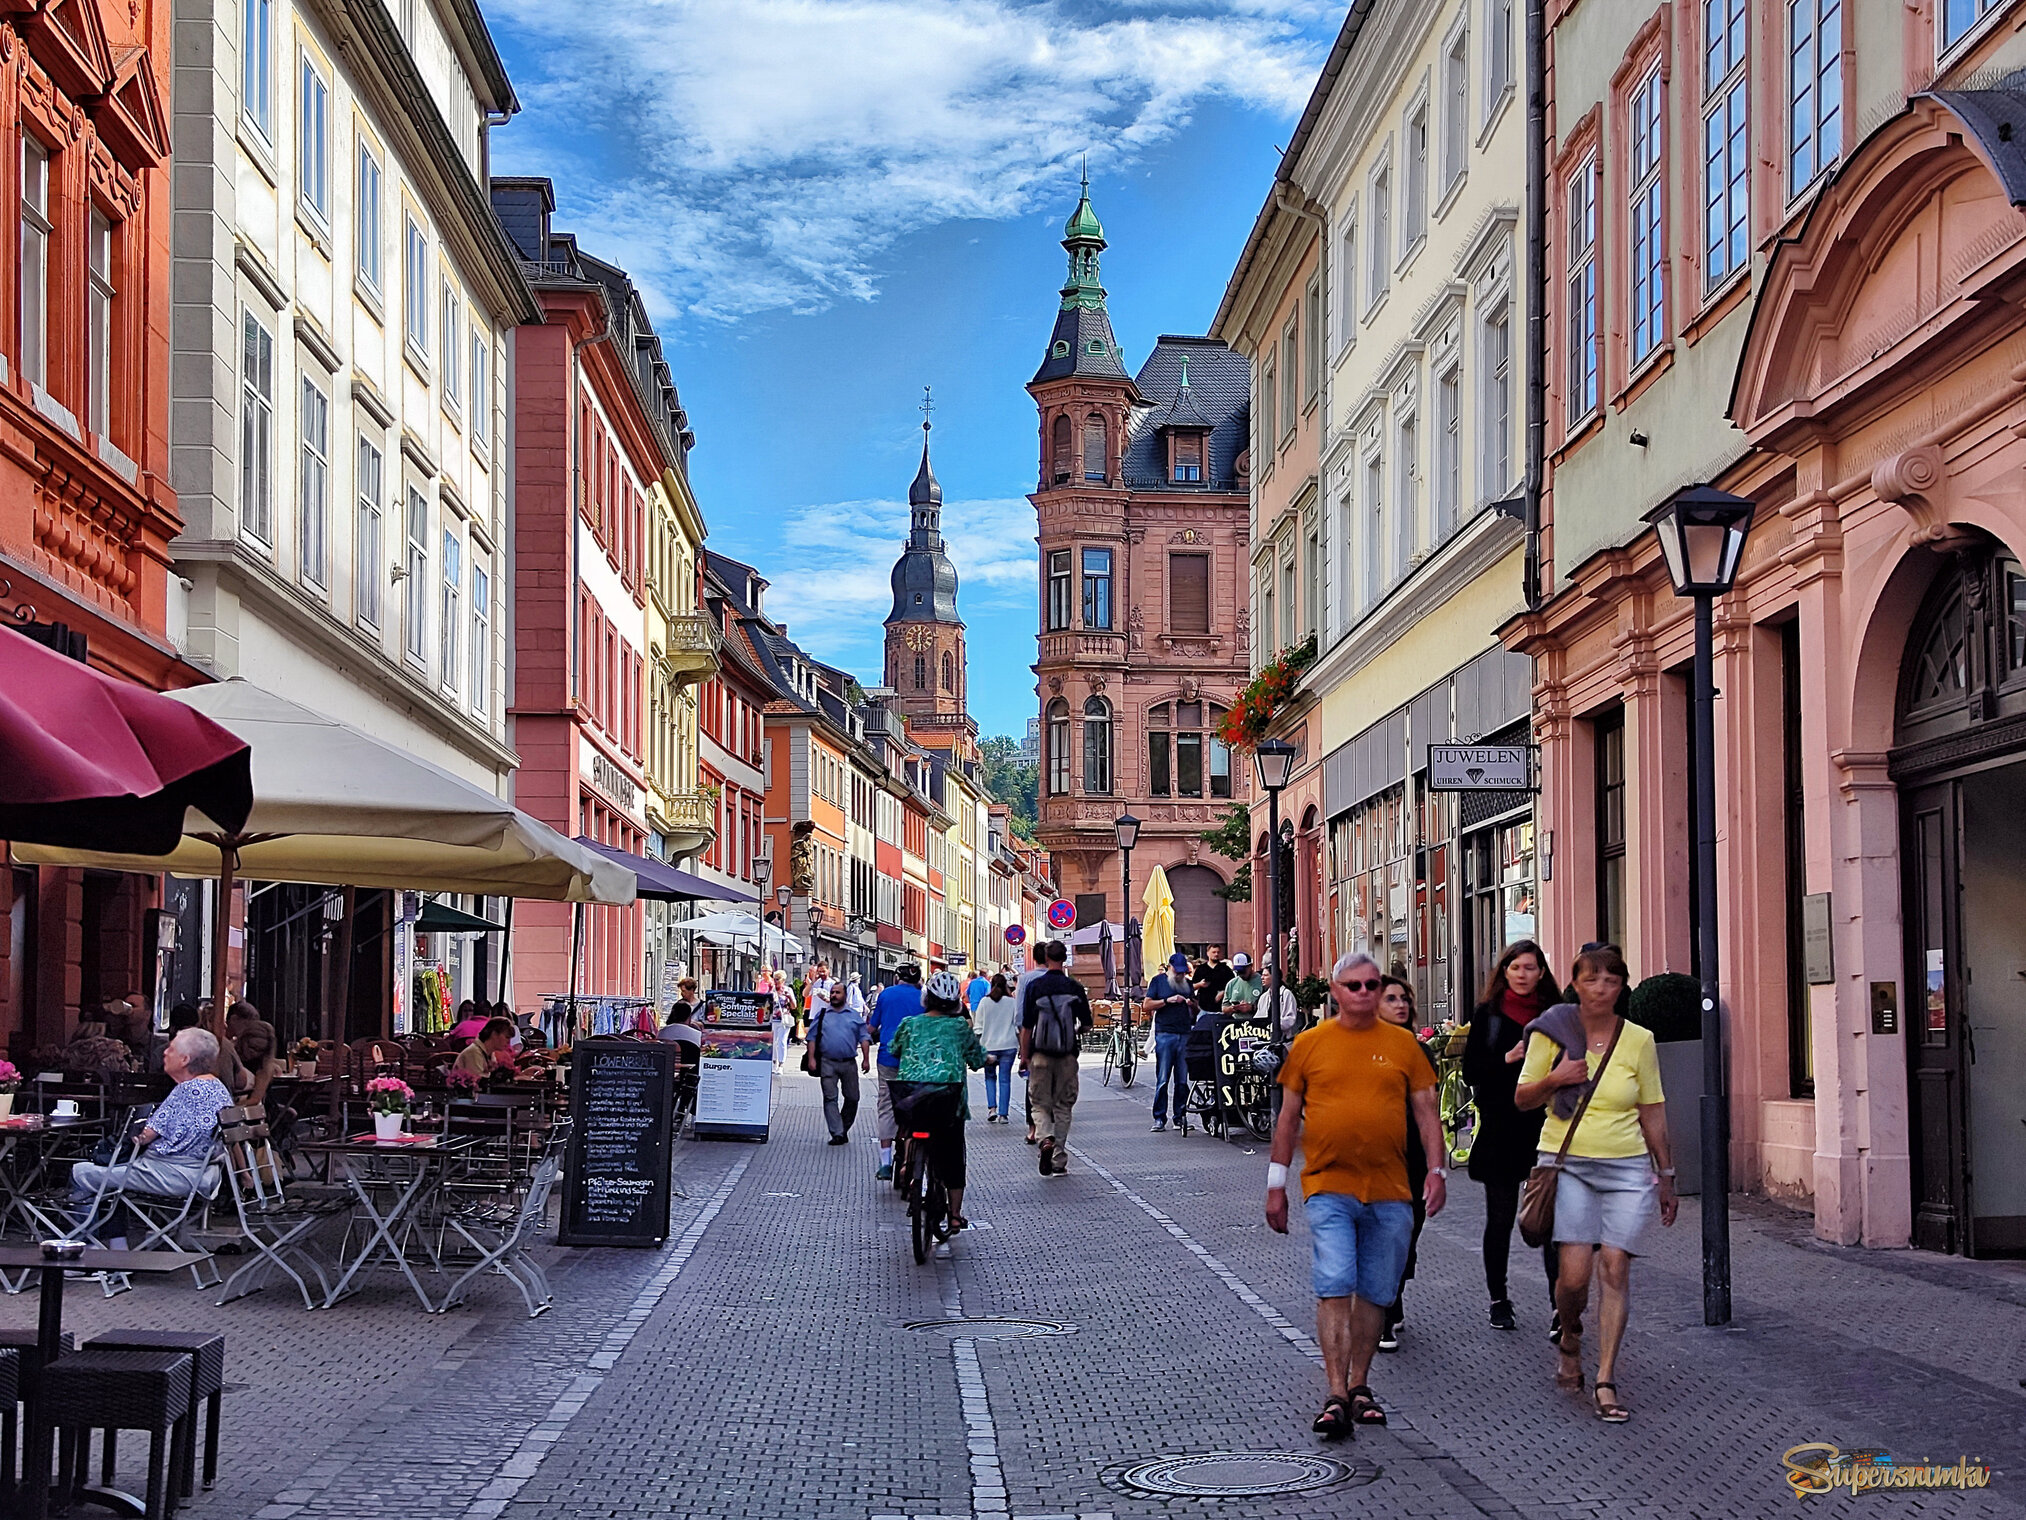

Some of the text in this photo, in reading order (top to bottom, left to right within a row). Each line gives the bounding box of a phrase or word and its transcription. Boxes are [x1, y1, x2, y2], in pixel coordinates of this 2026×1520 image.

[1436, 750, 1521, 764] JUWELEN
[1436, 777, 1522, 785] UHREN SCHMUCK
[720, 1009, 758, 1019] Specials!
[703, 1062, 733, 1071] Burger.
